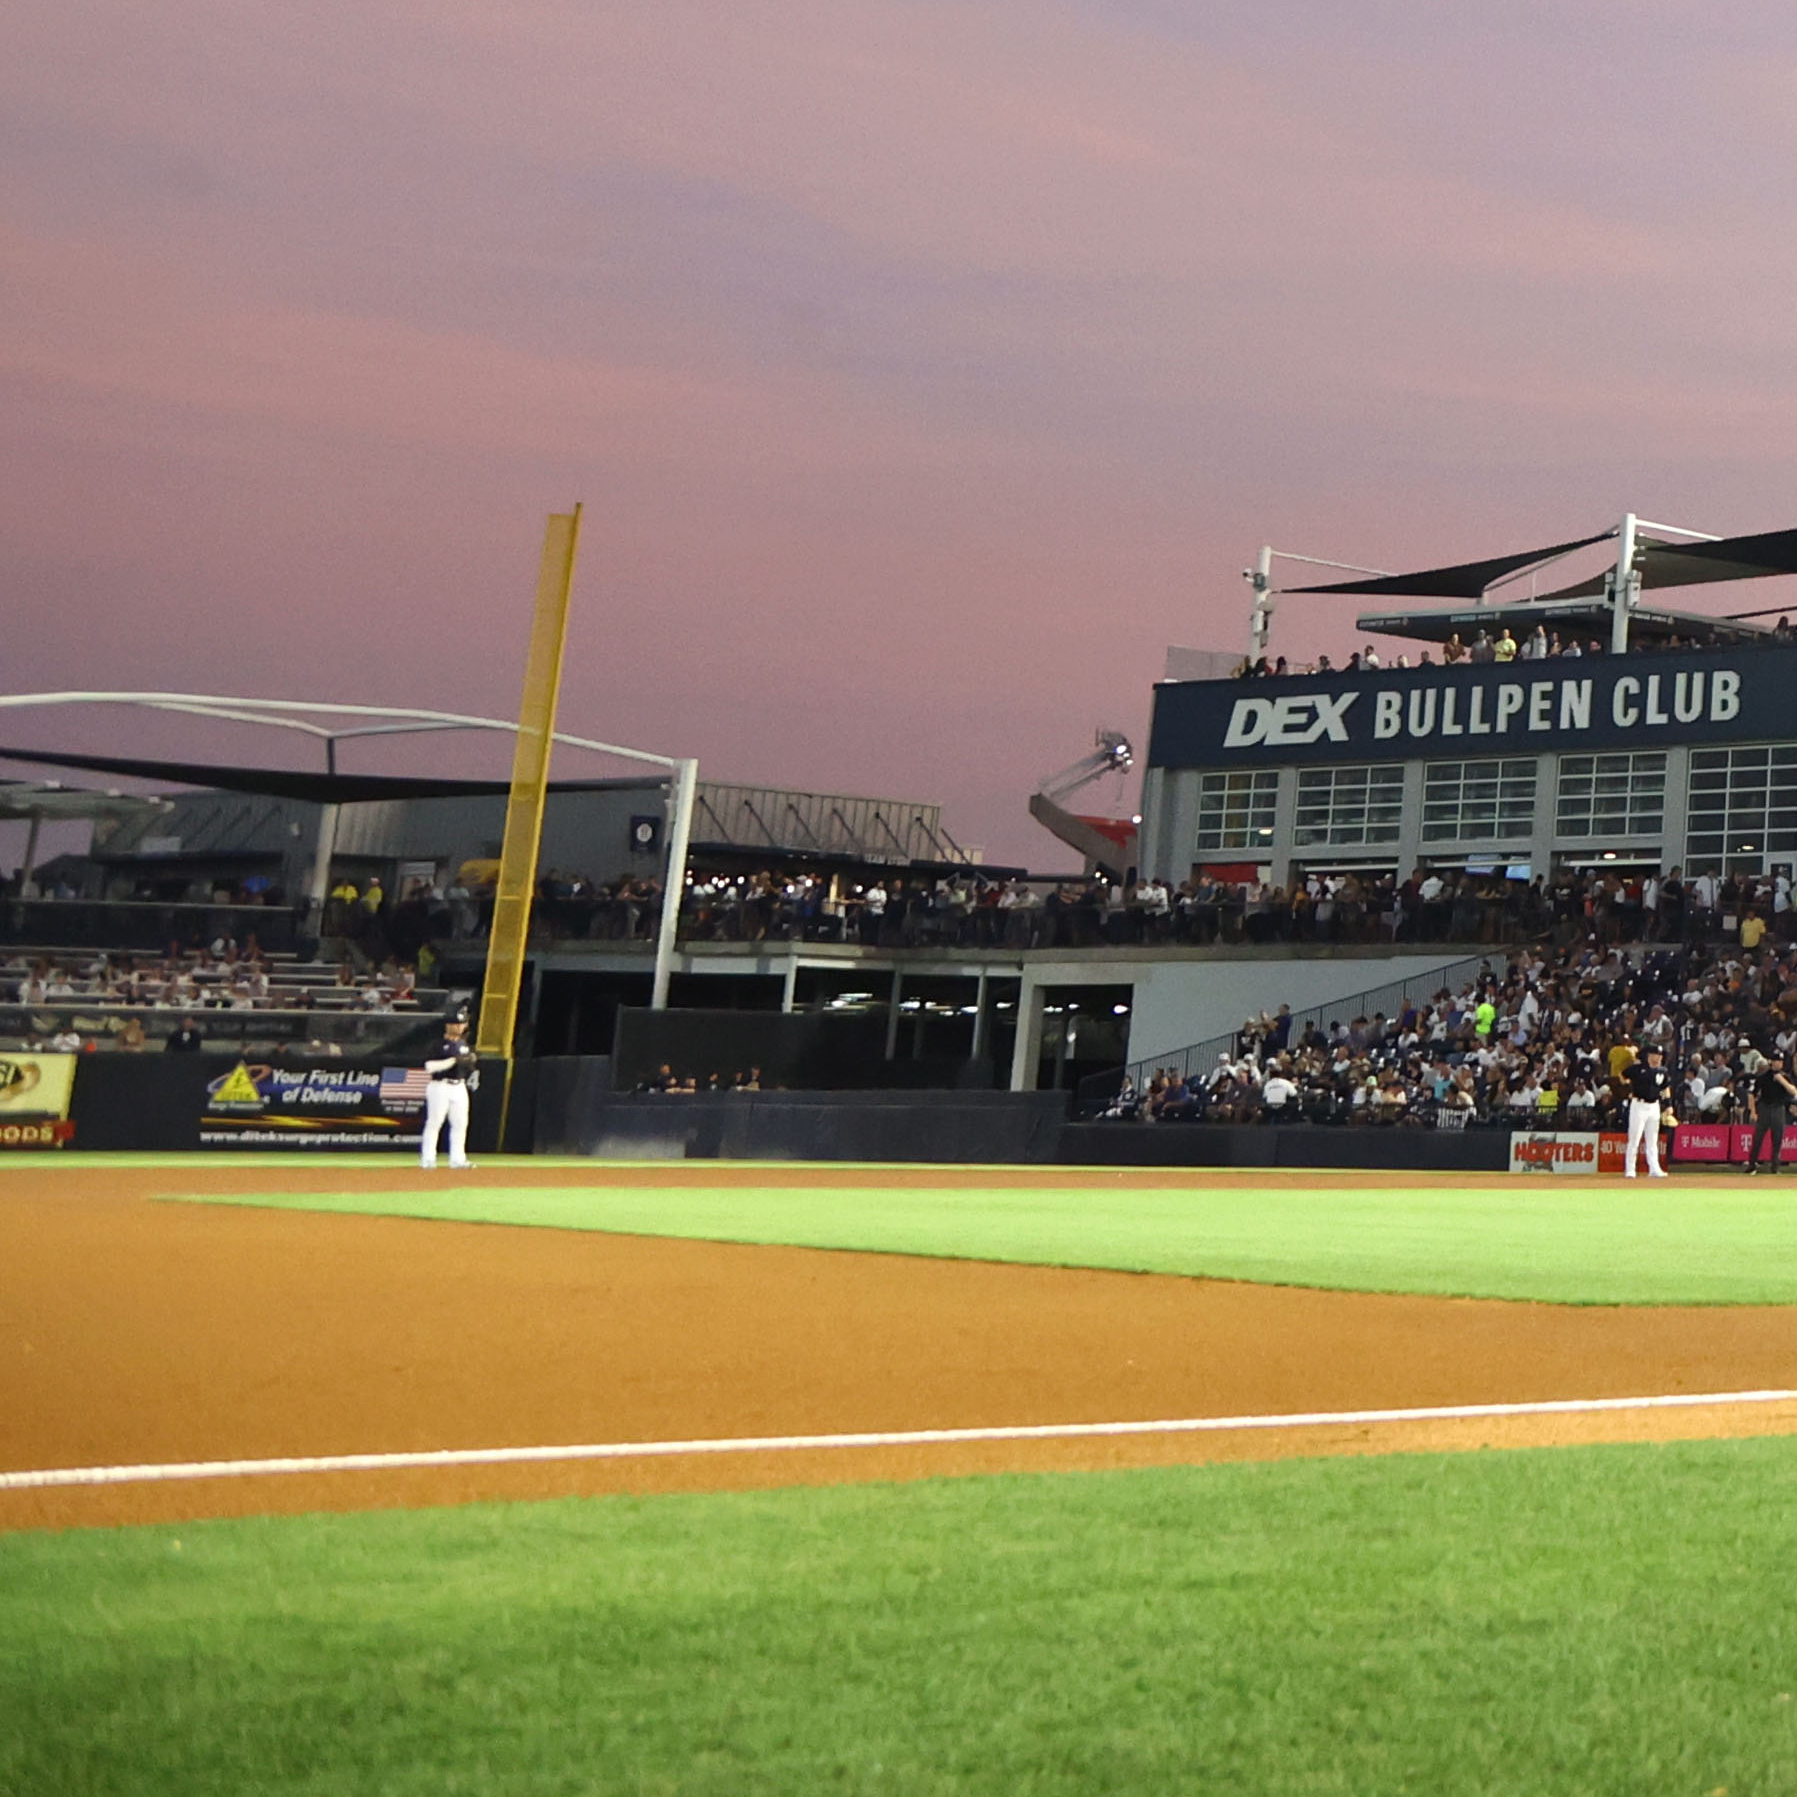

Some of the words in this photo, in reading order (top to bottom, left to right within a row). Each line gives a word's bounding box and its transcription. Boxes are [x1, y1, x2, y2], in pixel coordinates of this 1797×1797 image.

[1223, 691, 1360, 748] DEX
[1374, 679, 1593, 739] BULLPEN
[1612, 670, 1740, 727] CLUB
[273, 1069, 307, 1085] Your
[308, 1069, 345, 1086] First
[346, 1070, 380, 1086] Line
[282, 1086, 302, 1102] of
[301, 1087, 363, 1104] Defense
[1514, 1141, 1595, 1163] HOOTERS
